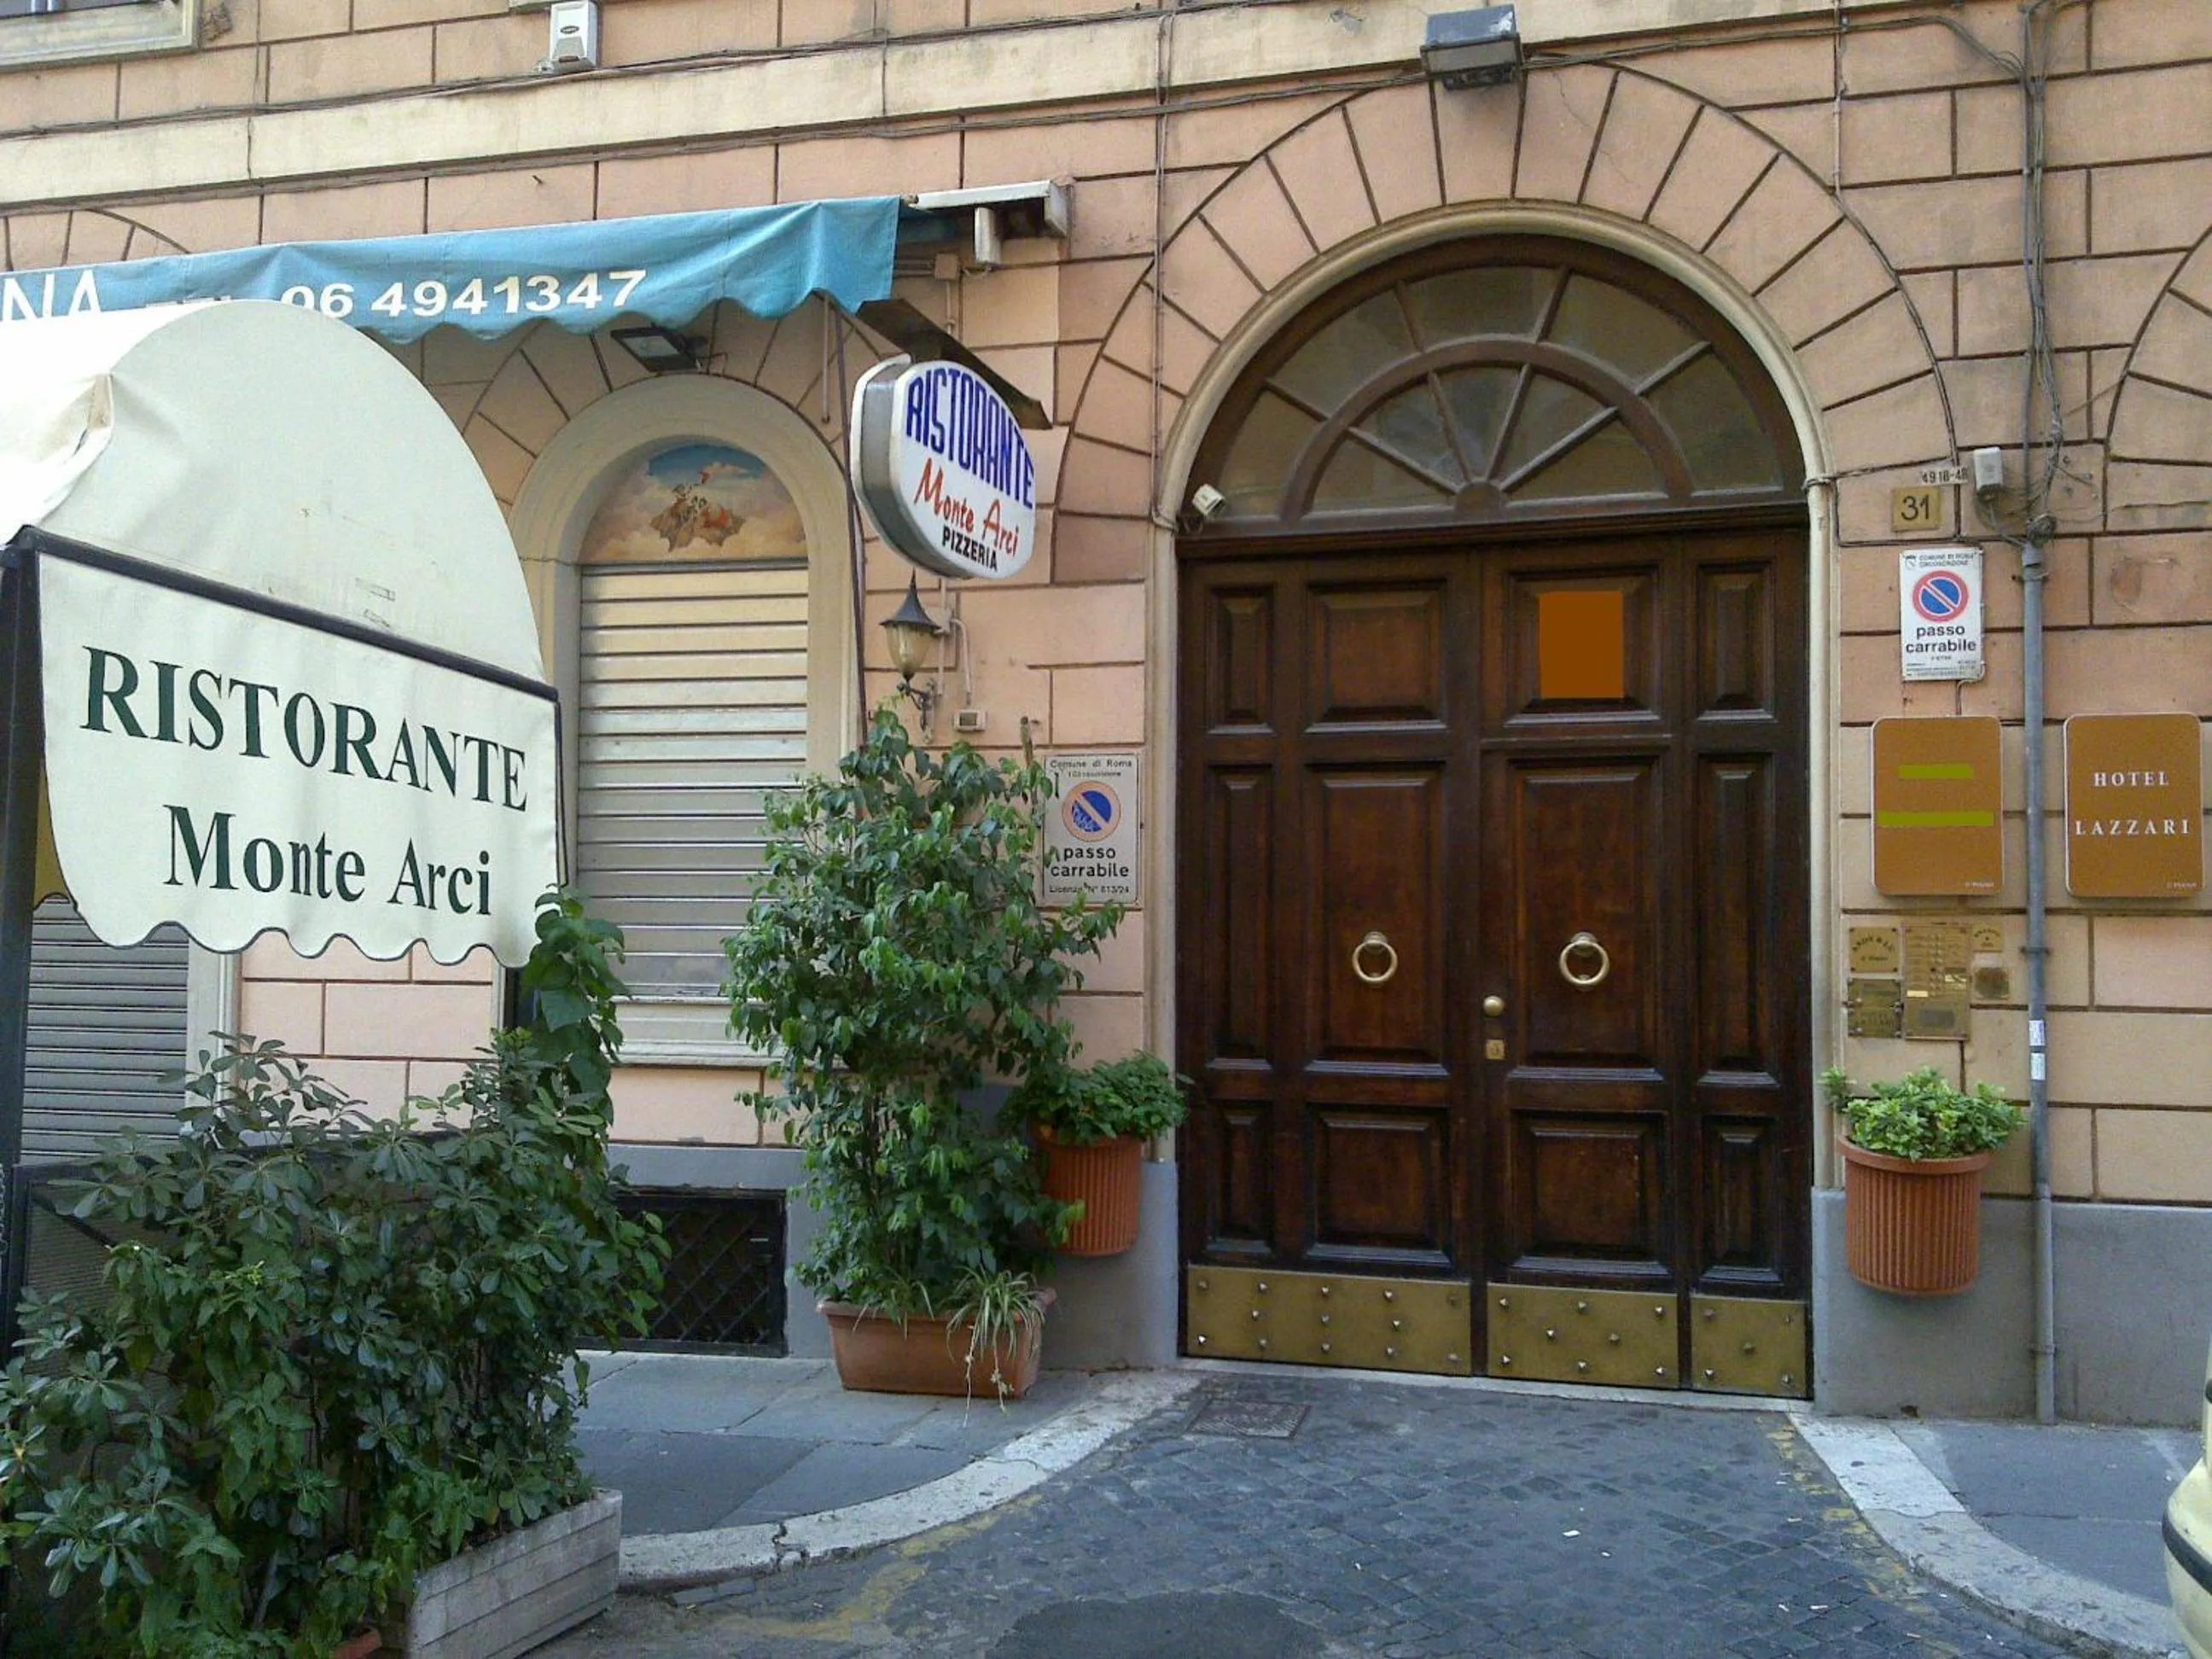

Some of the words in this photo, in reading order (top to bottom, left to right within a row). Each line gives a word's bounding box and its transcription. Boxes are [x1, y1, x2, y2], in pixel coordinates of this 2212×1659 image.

[371, 269, 646, 317] 4941347
[905, 368, 1034, 509] RISTORANTE
[914, 457, 974, 533] Monte
[981, 498, 1019, 557] Arci
[1901, 495, 1929, 521] 31
[941, 526, 998, 571] PIZZERIA
[1917, 626, 1965, 639] passo
[1906, 638, 1977, 653] carrabile
[80, 646, 527, 812] RISTORANTE
[1050, 759, 1086, 768] Comune
[1107, 759, 1132, 767] Roma
[2093, 771, 2169, 787] HOTEL
[2075, 818, 2190, 835] LAZZARI
[162, 805, 365, 903] Monte
[387, 838, 492, 915] Arci
[1063, 847, 1116, 860] passo
[1051, 863, 1129, 877] carrabile
